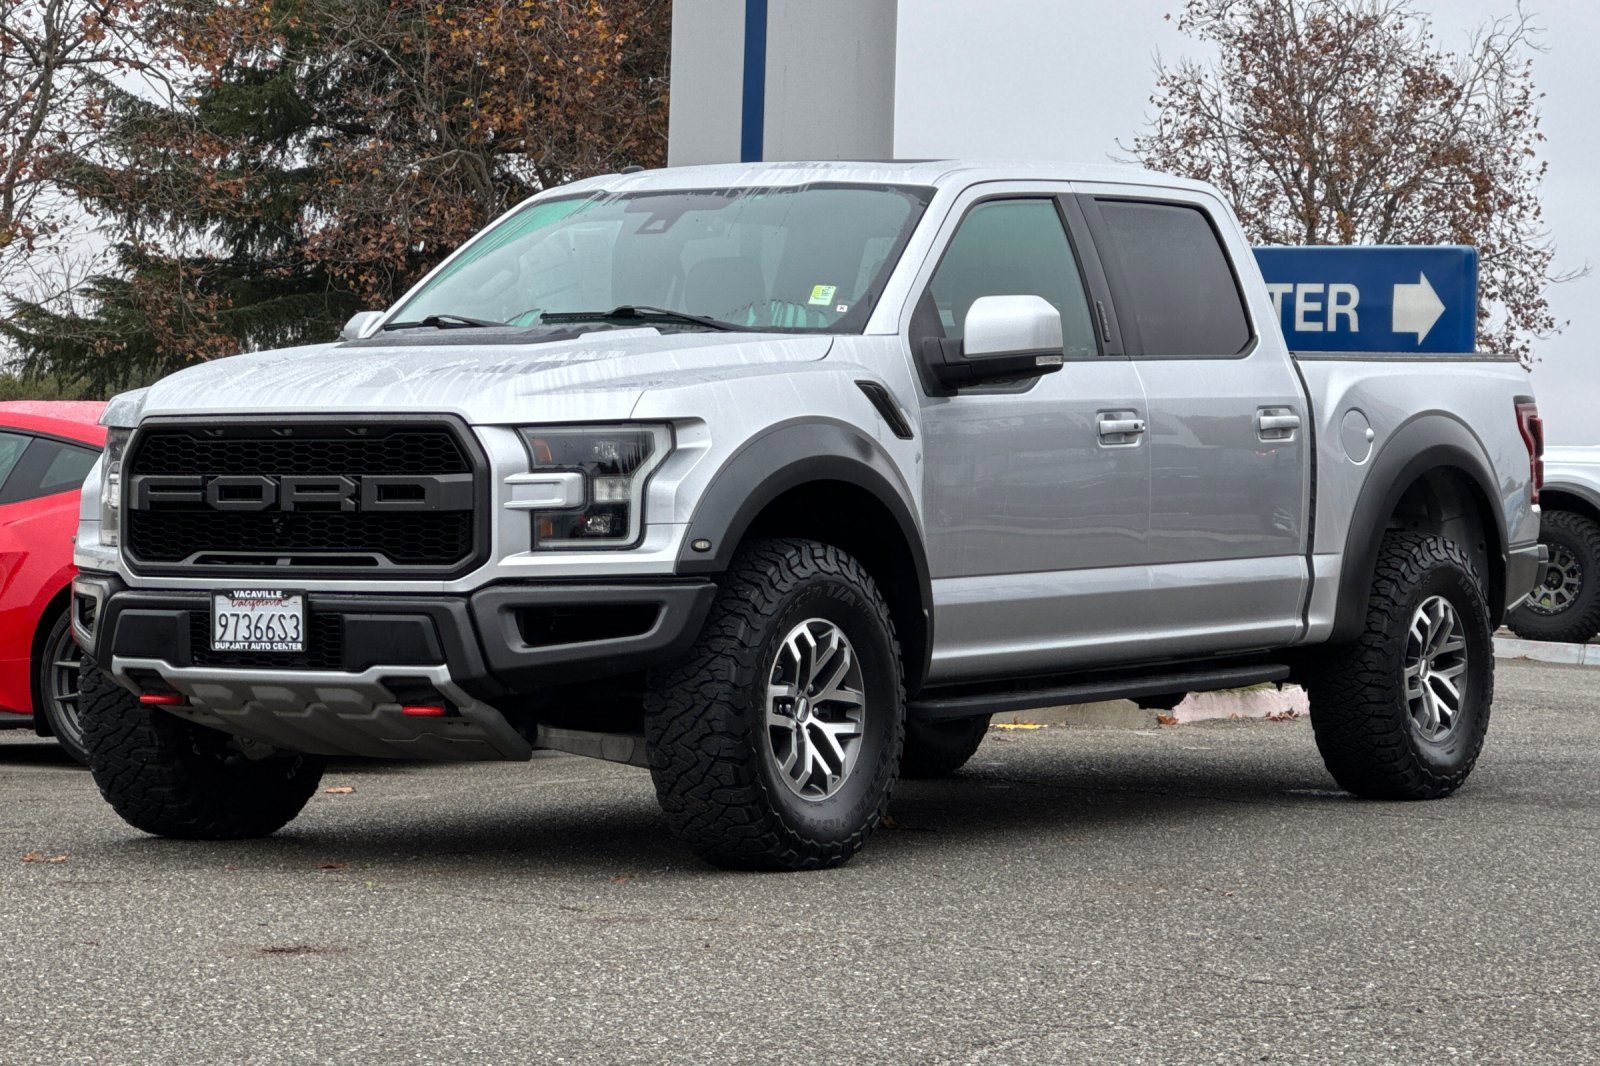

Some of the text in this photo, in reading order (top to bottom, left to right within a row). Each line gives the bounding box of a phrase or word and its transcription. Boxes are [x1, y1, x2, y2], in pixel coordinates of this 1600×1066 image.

[1265, 283, 1360, 332] TER
[136, 474, 443, 512] FORD
[233, 590, 282, 598] VACAVILLE
[218, 613, 300, 640] 97366S3
[272, 642, 302, 650] CENTER
